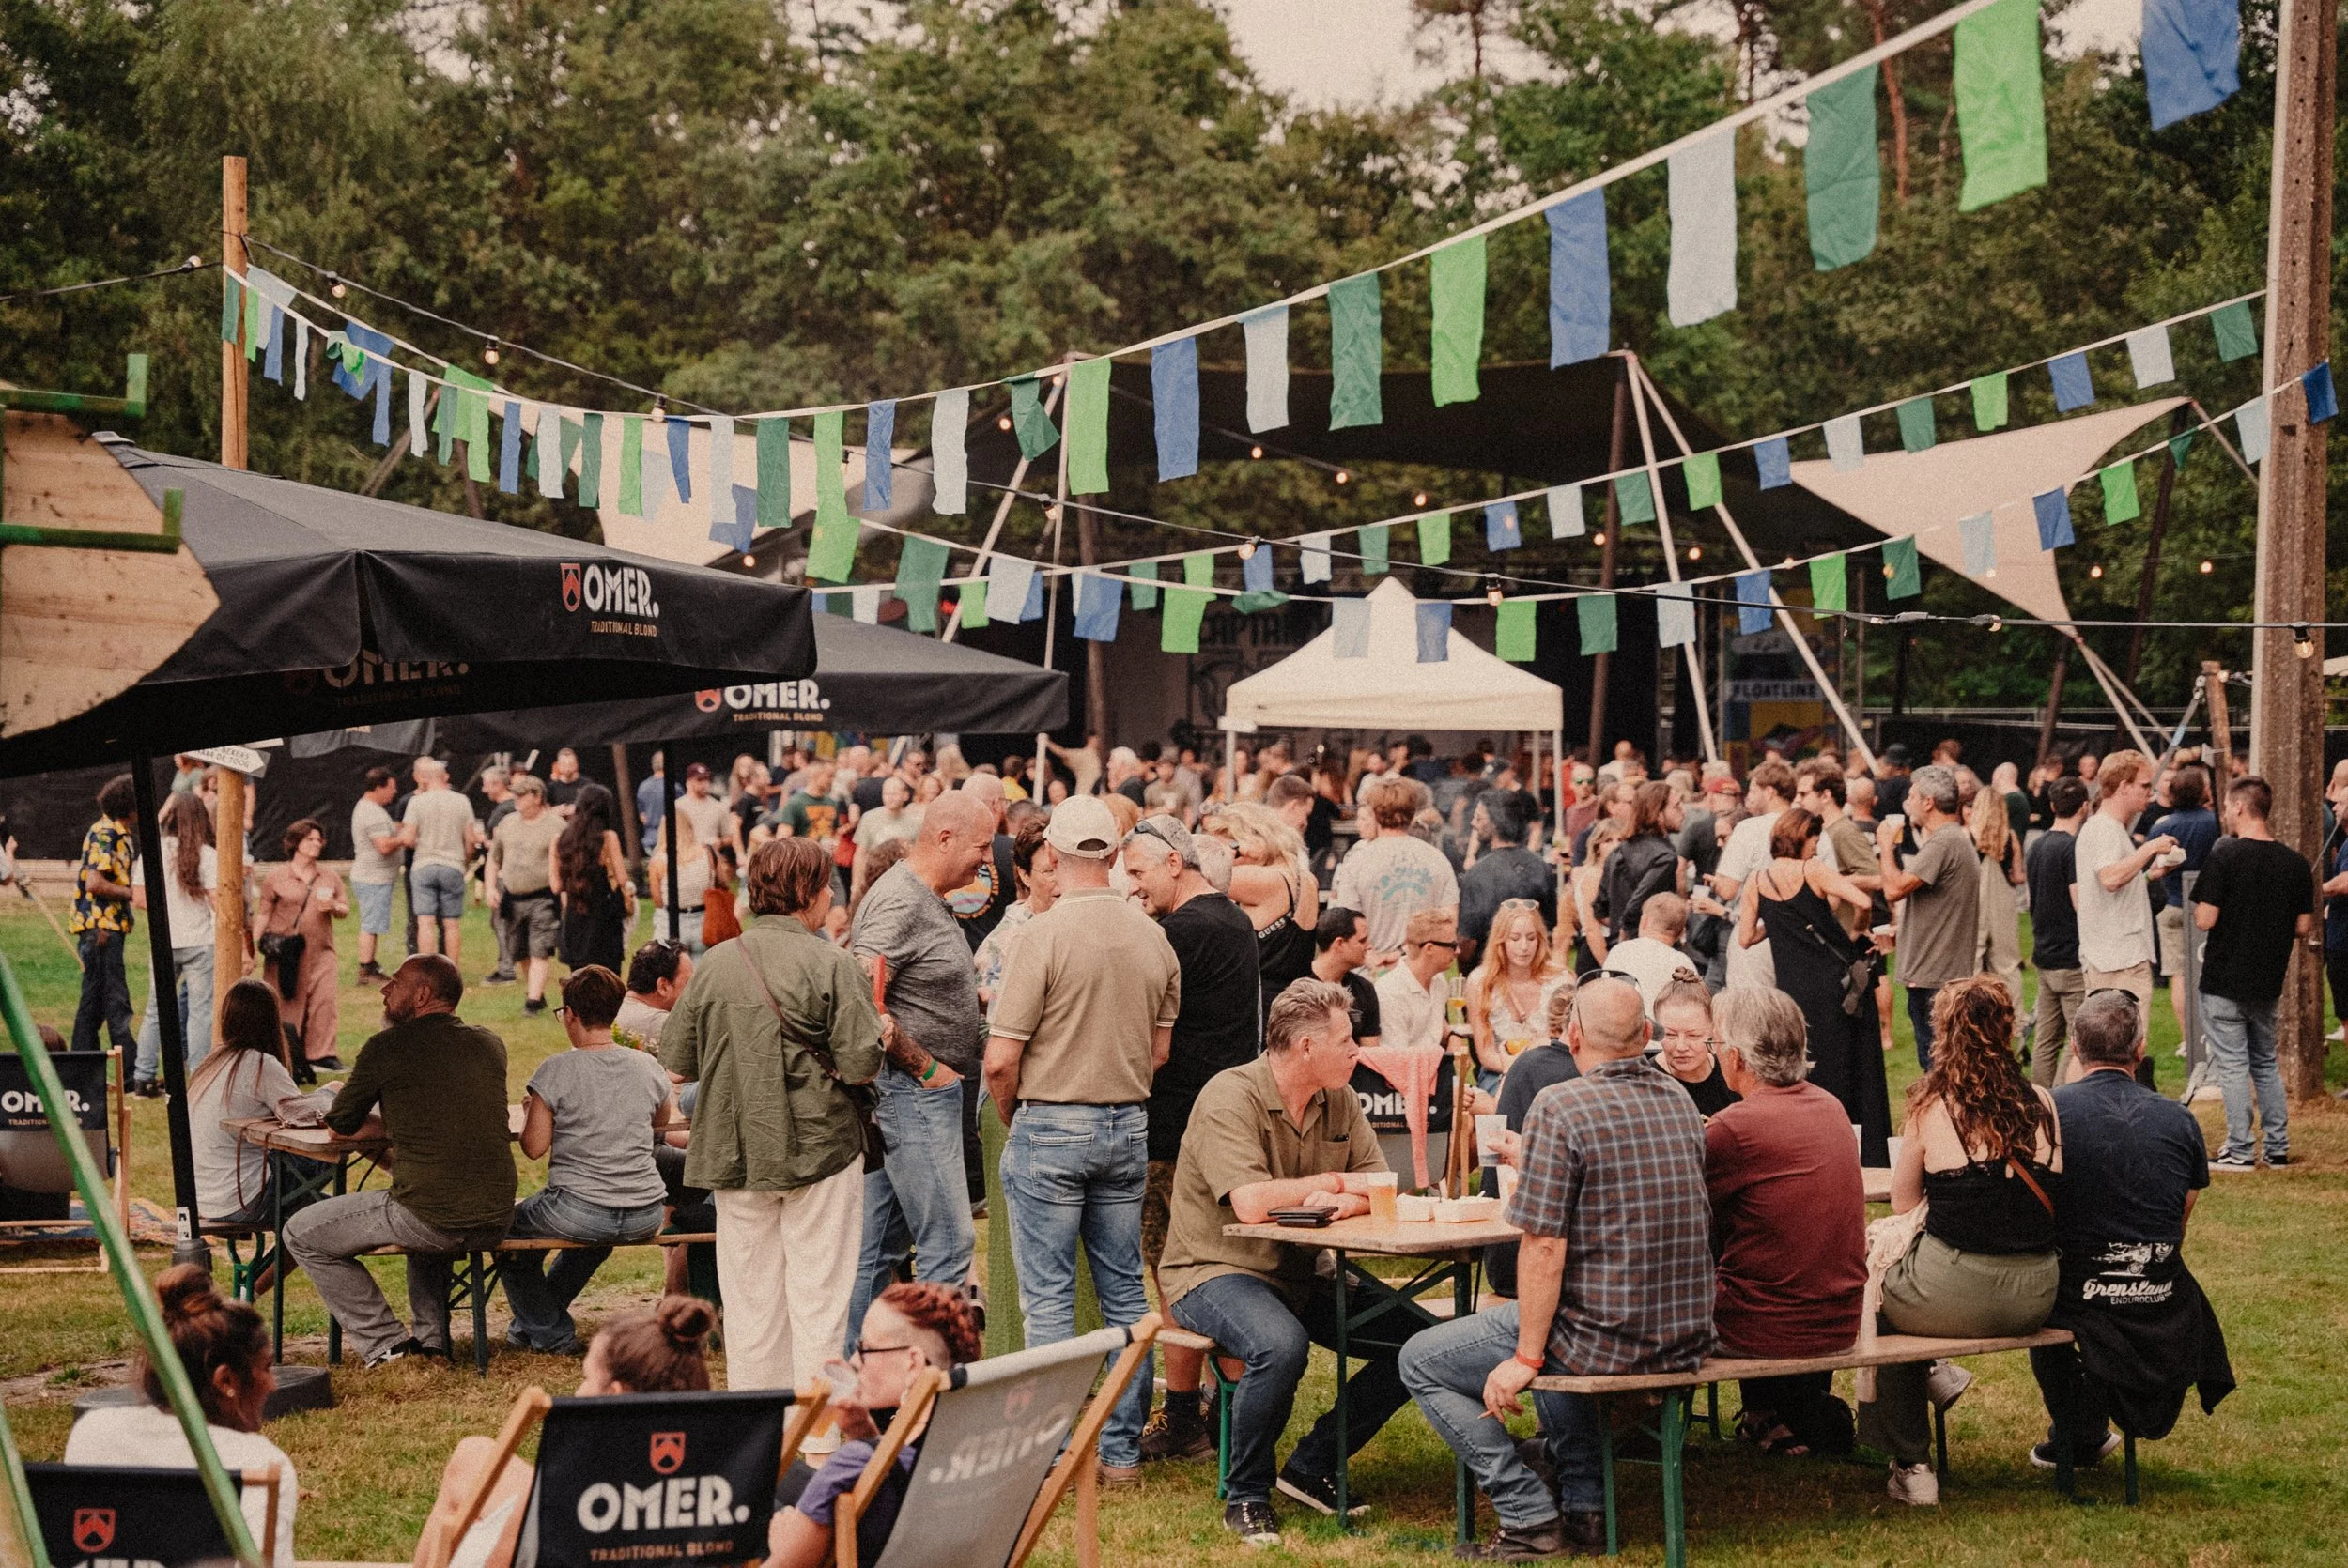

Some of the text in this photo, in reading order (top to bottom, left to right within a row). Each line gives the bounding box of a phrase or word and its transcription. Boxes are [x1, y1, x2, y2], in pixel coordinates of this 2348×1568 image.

[583, 563, 659, 618] OMER.
[590, 621, 657, 637] TRADITIONAL BLOND
[724, 679, 831, 710] OMER.
[733, 711, 824, 722] TRADITIONAL BLOND
[1258, 917, 1286, 939] GUESS
[1, 1090, 90, 1113] OMR.
[1357, 1092, 1438, 1115] OME.
[2110, 1295, 2166, 1305] ENDUROCLUB
[577, 1474, 750, 1533] OMER.
[590, 1539, 734, 1562] TRADITIONAL BLOND
